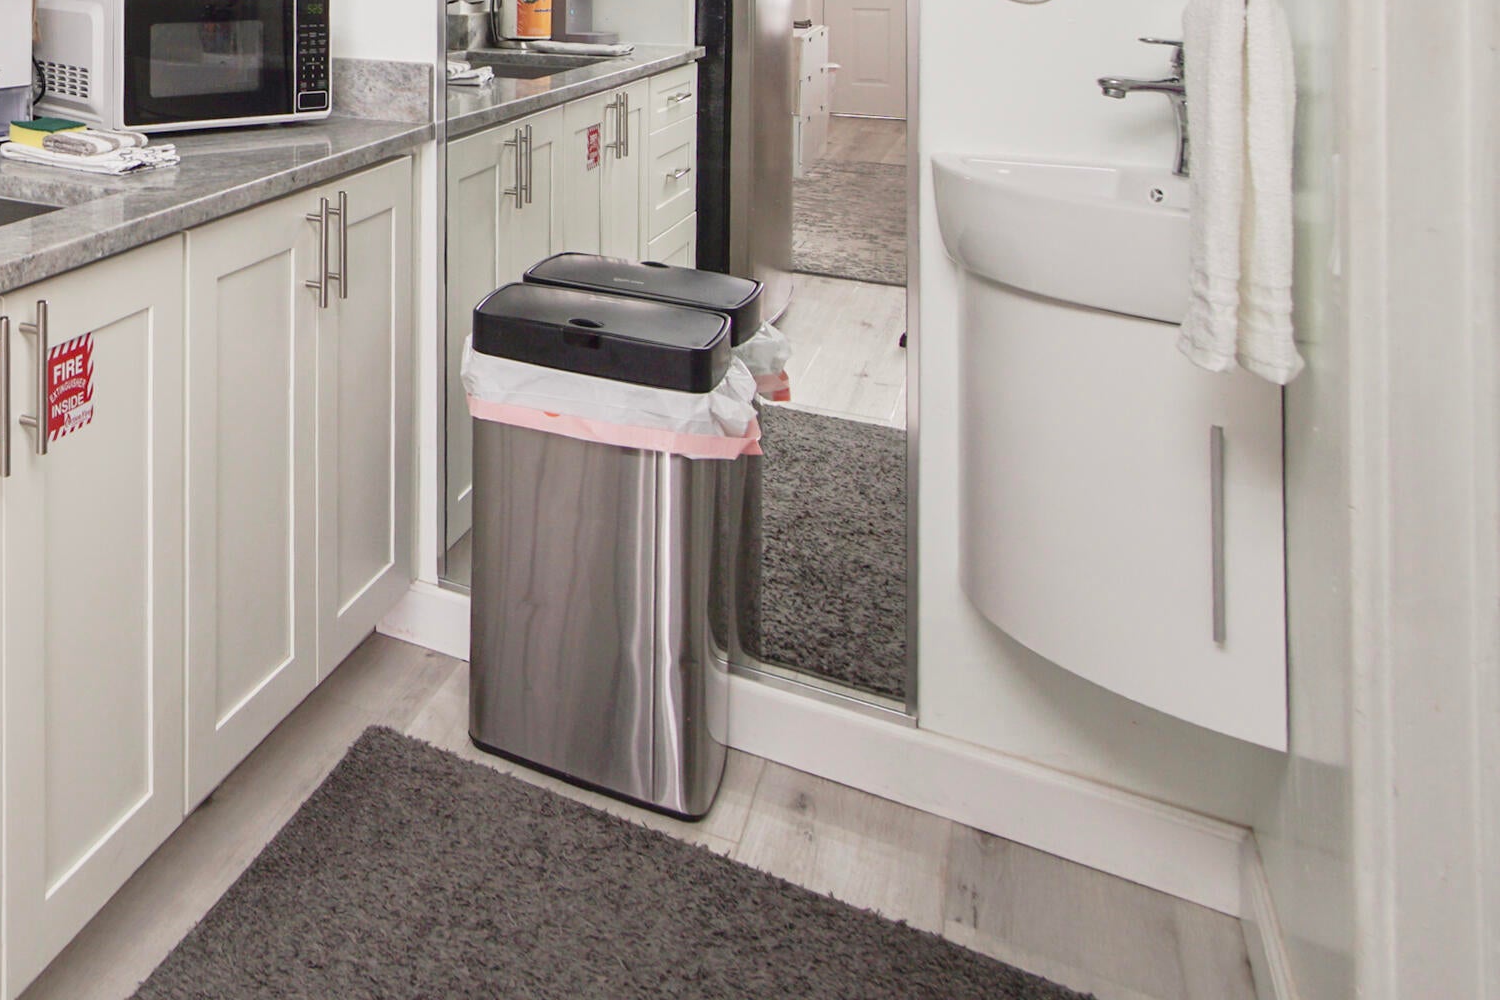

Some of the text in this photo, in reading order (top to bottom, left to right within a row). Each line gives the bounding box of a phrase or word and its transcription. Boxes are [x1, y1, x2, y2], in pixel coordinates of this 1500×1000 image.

[53, 353, 84, 385] FIRE
[49, 377, 87, 403] EXTINGUISHER
[52, 391, 85, 419] INSIDE
